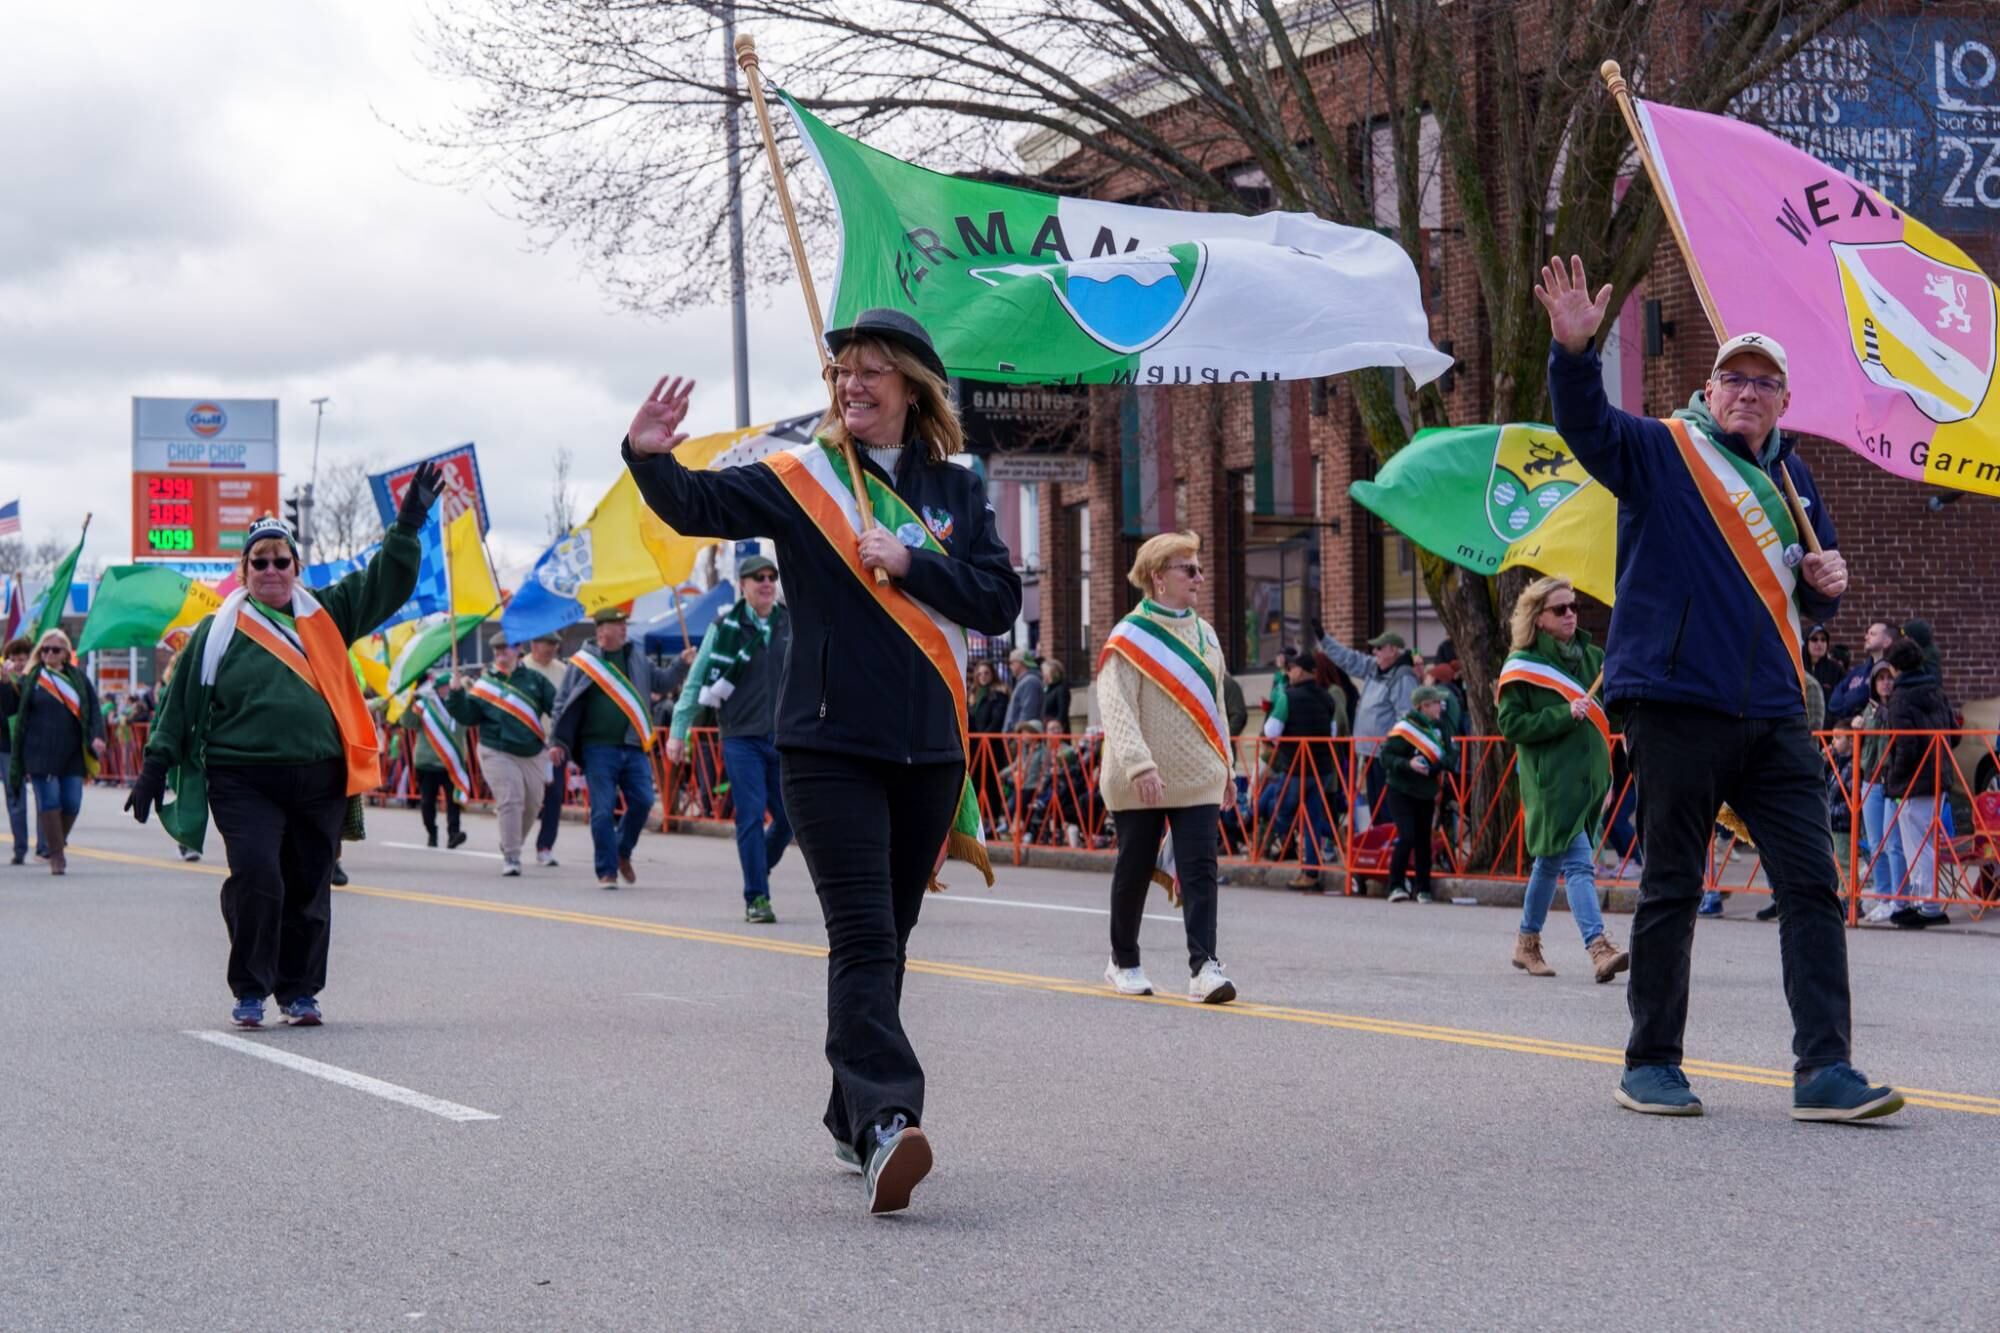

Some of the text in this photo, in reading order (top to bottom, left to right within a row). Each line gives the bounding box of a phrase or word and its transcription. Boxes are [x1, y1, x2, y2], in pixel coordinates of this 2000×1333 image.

[190, 414, 221, 425] Gulf
[168, 443, 246, 461] CHOP CHOP
[1729, 491, 1779, 549] AOH
